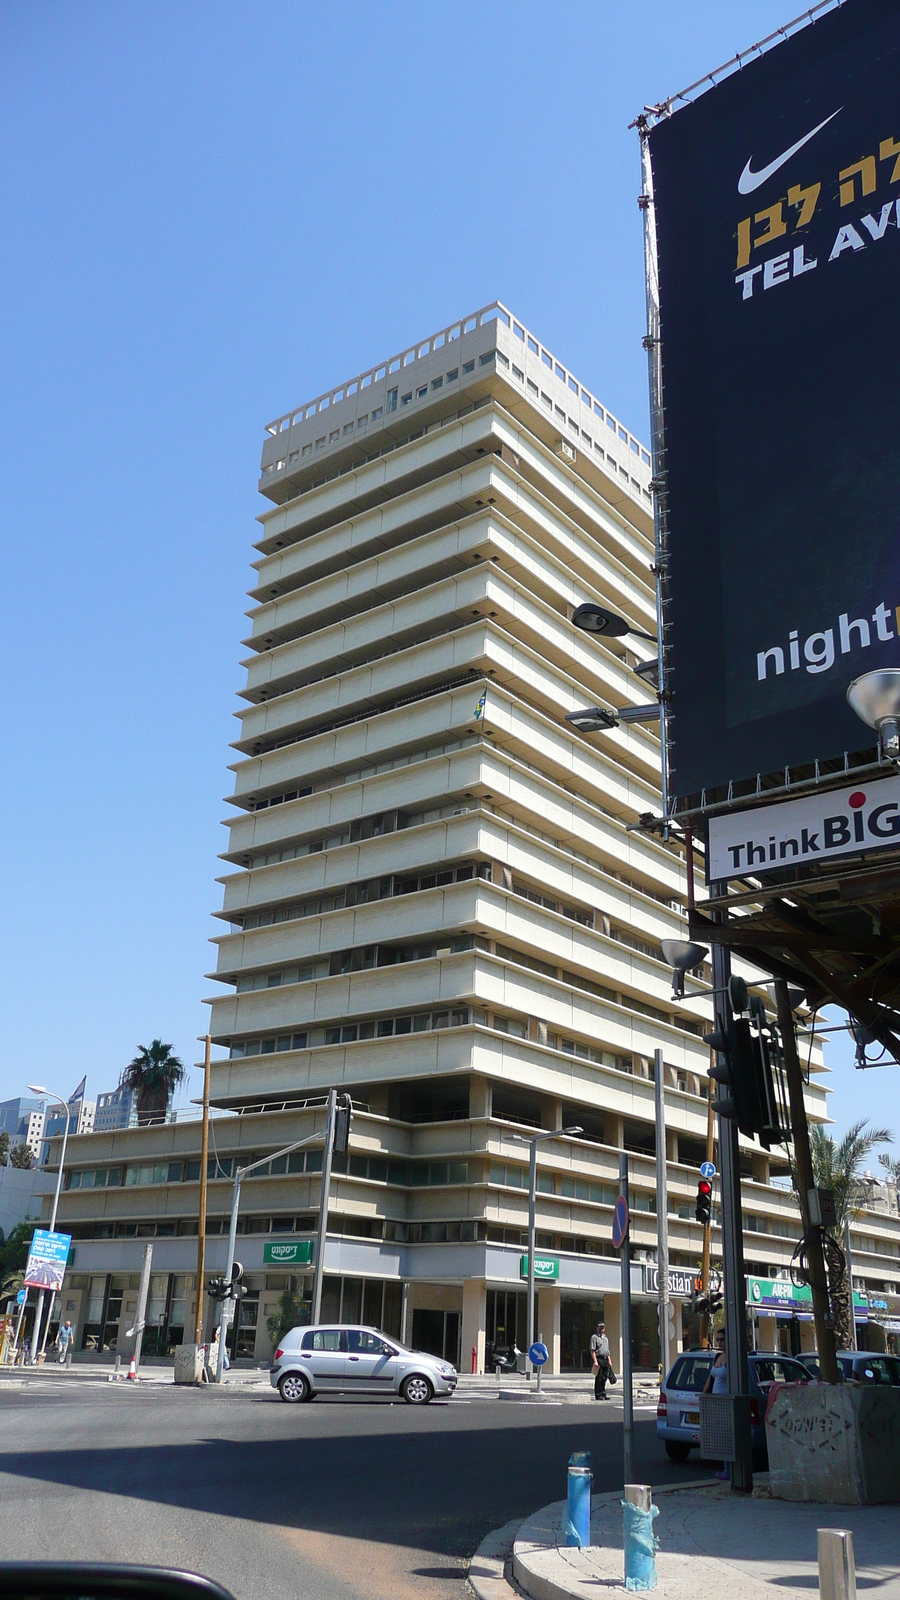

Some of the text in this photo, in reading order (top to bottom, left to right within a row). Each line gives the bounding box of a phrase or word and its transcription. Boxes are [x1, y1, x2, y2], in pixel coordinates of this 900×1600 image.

[735, 182, 821, 270] לבן
[735, 244, 818, 300] TEL
[756, 602, 900, 681] night
[271, 1245, 298, 1256] דיסקונט
[653, 1270, 691, 1292] Cstian
